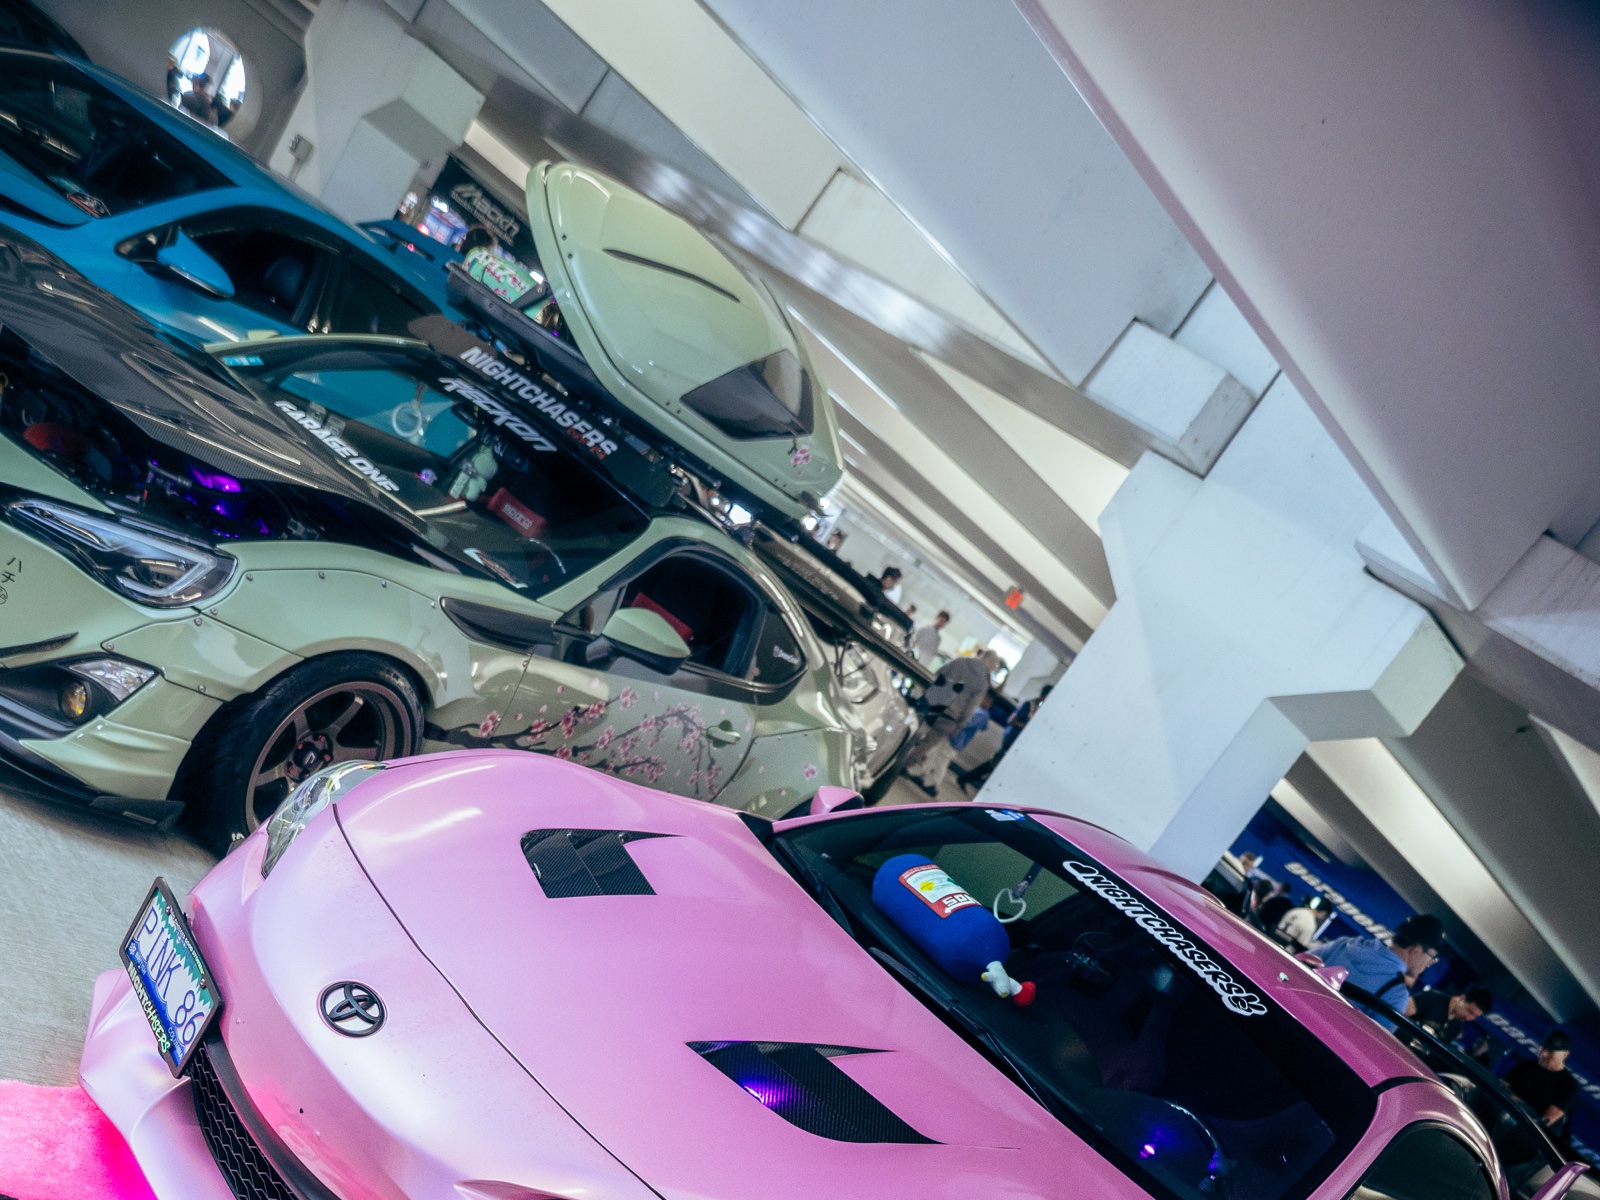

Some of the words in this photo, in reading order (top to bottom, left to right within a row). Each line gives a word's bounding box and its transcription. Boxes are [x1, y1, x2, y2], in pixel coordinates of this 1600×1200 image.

[275, 400, 359, 458] GARAGE
[459, 346, 619, 457] NIGHTCHASERS
[136, 906, 182, 999] PINK
[175, 990, 205, 1045] 86
[1084, 870, 1247, 1001] NIGHTCHASERS
[127, 961, 171, 1053] NIGHTCHASERS
